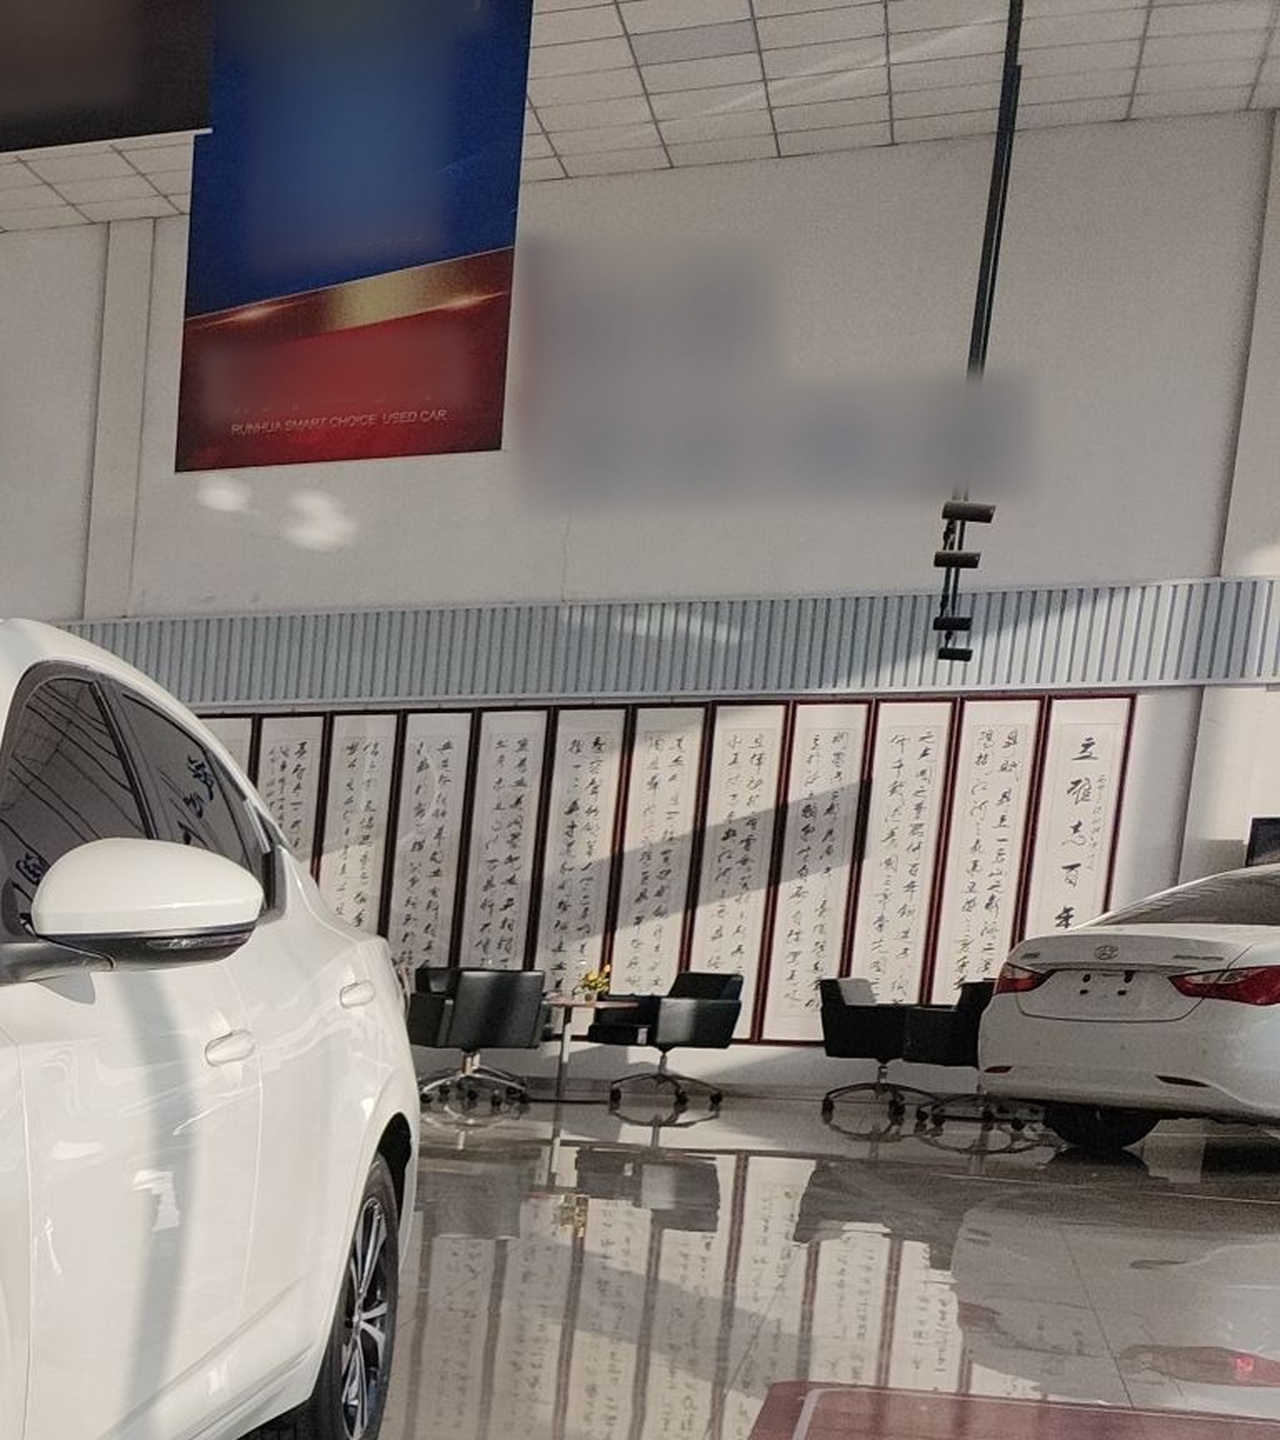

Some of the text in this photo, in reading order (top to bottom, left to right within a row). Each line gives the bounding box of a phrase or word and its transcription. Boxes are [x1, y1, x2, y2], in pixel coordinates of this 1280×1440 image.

[231, 408, 449, 436] RUNHUA SMART CHOICE USED CAR
